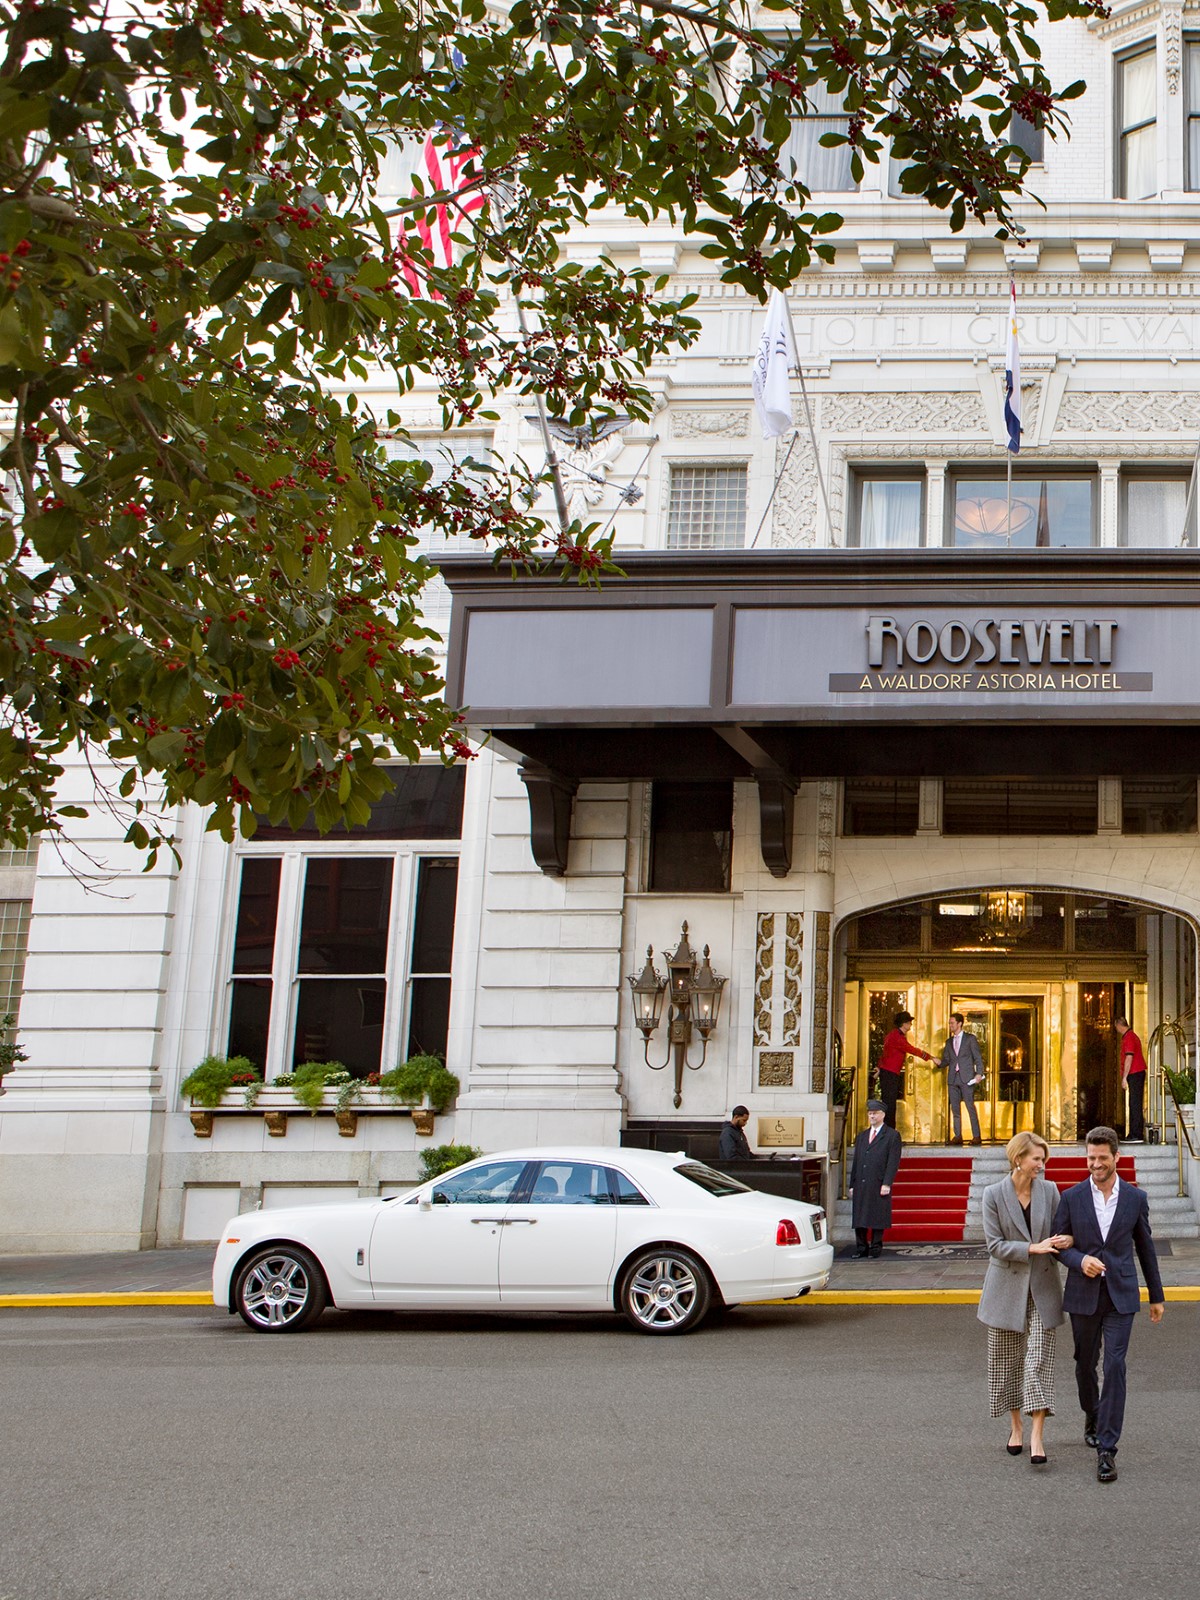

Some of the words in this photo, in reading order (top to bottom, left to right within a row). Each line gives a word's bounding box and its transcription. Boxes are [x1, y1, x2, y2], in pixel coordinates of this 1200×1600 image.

[865, 615, 1119, 667] ROOSEVELT
[860, 673, 873, 690] A
[877, 673, 973, 690] WALDORF
[976, 673, 1057, 690] ASTORIA
[1061, 673, 1122, 690] HOTEL
